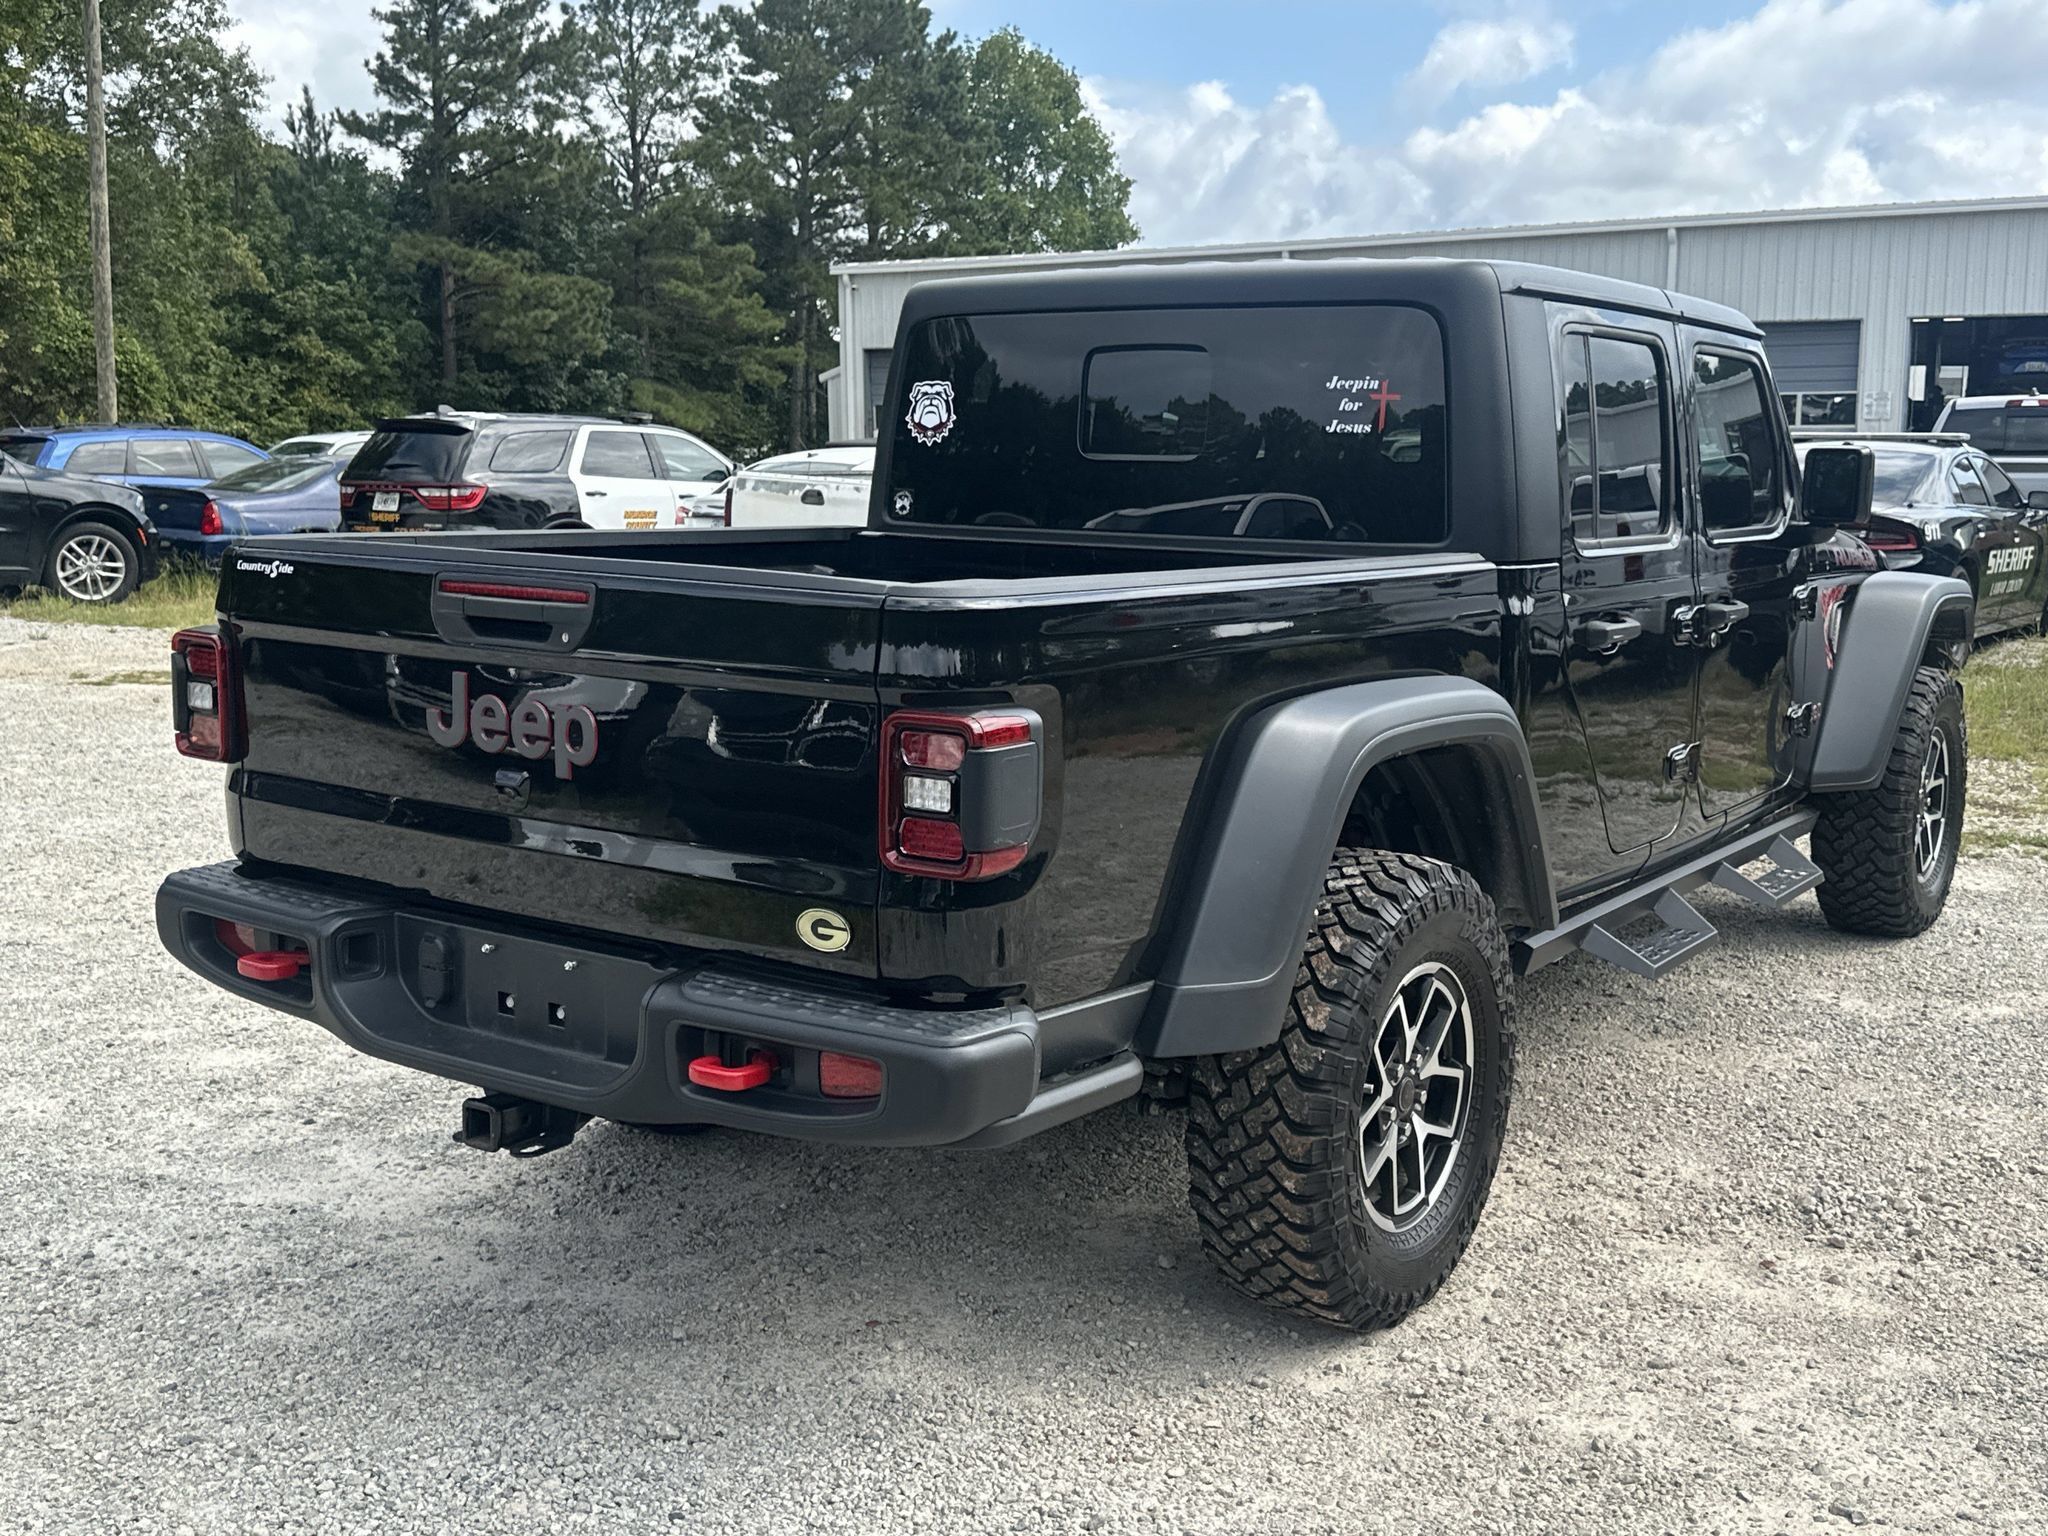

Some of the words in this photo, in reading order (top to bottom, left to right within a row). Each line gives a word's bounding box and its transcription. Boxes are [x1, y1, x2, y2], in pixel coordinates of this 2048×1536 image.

[1326, 376, 1379, 393] Jeepin
[1339, 398, 1363, 411] for
[1325, 420, 1372, 433] Jesus
[1924, 524, 1941, 541] 911
[1986, 546, 2035, 574] SHERIFF
[426, 671, 599, 780] Jeep
[796, 908, 851, 952] G
